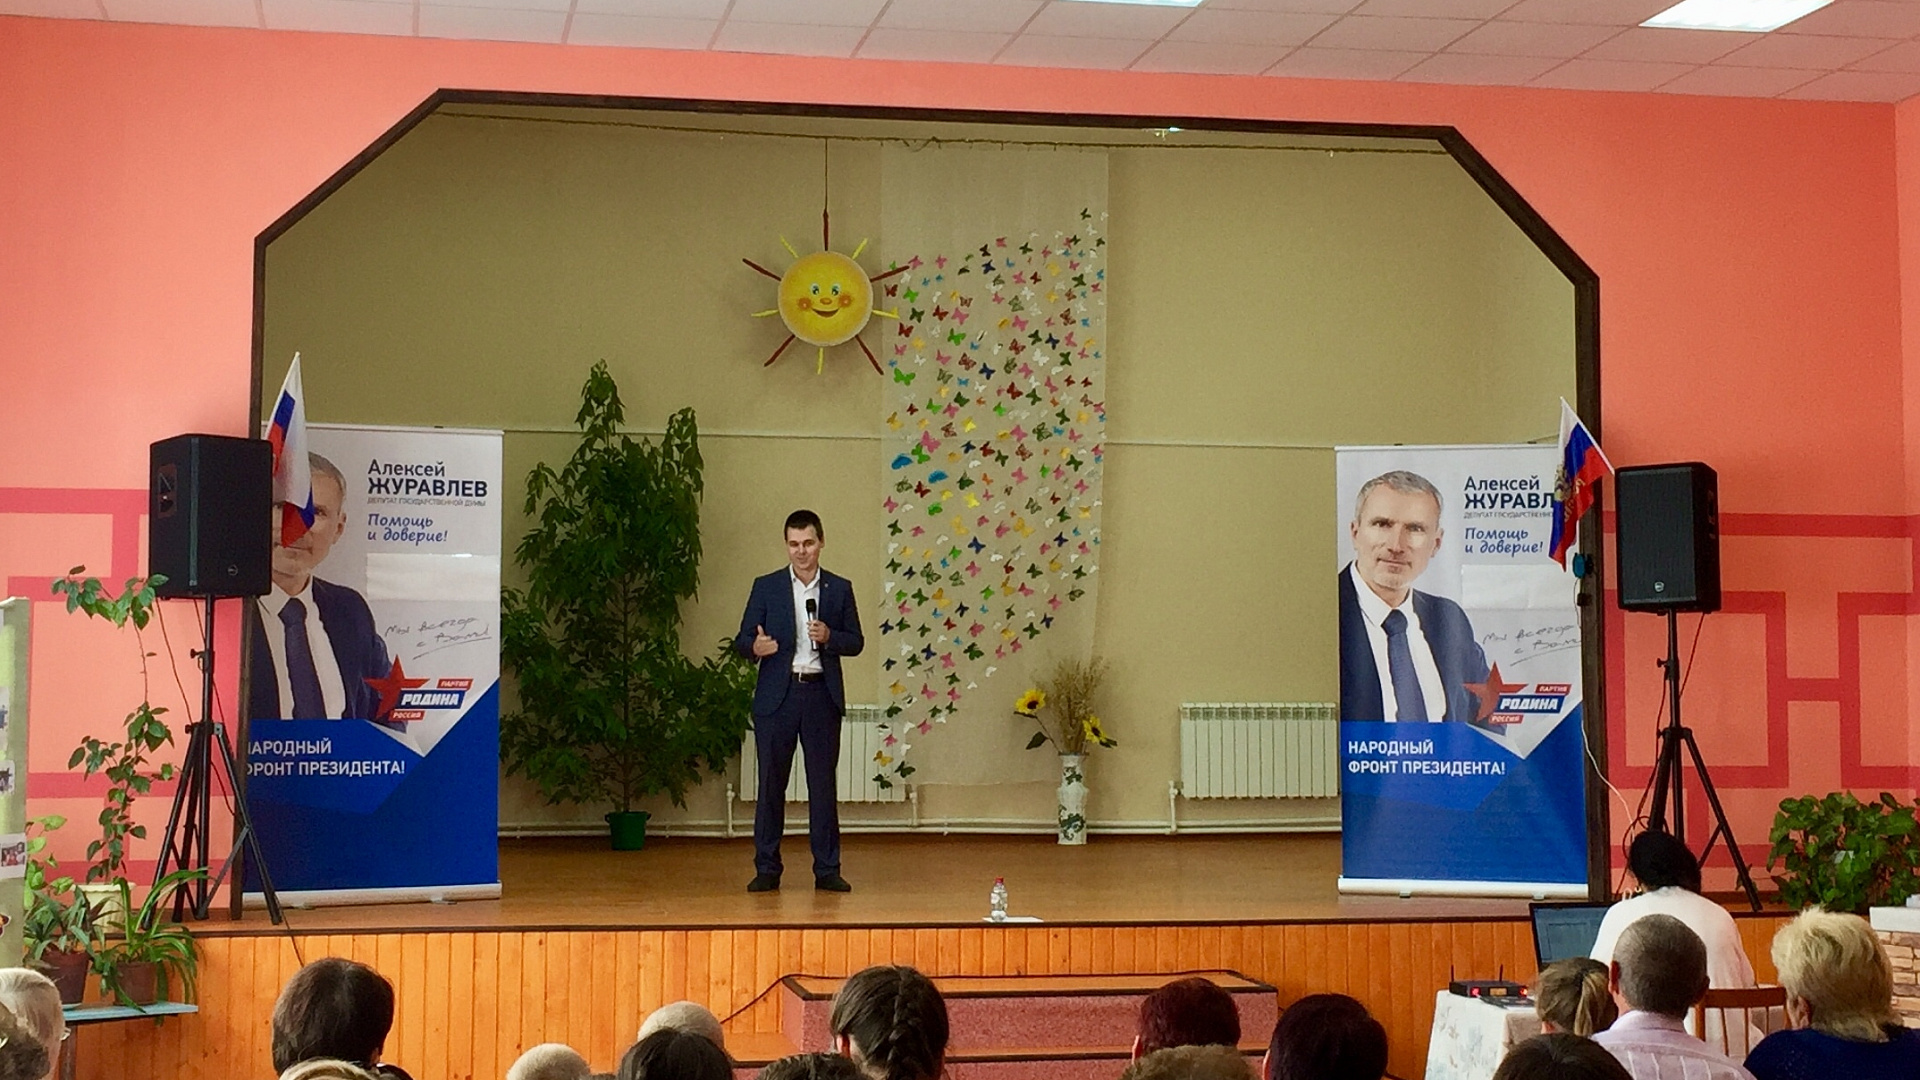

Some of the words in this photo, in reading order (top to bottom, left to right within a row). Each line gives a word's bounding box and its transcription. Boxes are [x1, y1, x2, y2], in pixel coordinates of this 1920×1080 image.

[368, 459, 445, 477] Алексей
[368, 477, 488, 497] ЖУРАВЛЕВ
[1464, 475, 1540, 491] Алексей
[1464, 492, 1555, 509] ЖУРАВЛ
[368, 513, 433, 530] Помощь
[367, 531, 377, 541] и
[384, 527, 448, 546] доверие!
[1465, 527, 1529, 542] Помощь
[1465, 544, 1473, 553] и
[1480, 539, 1544, 557] доверие!
[401, 693, 460, 706] РОДИНА
[1500, 697, 1560, 710] РОДИНА
[392, 711, 422, 719] РОССИЯ
[1348, 739, 1434, 757] НАРОДНЫЙ
[298, 760, 405, 777] ПРЕЗИДЕНТА!
[1348, 760, 1398, 774] ФРОНТ
[1402, 761, 1506, 777] ПРЕЗИДЕНТА!
